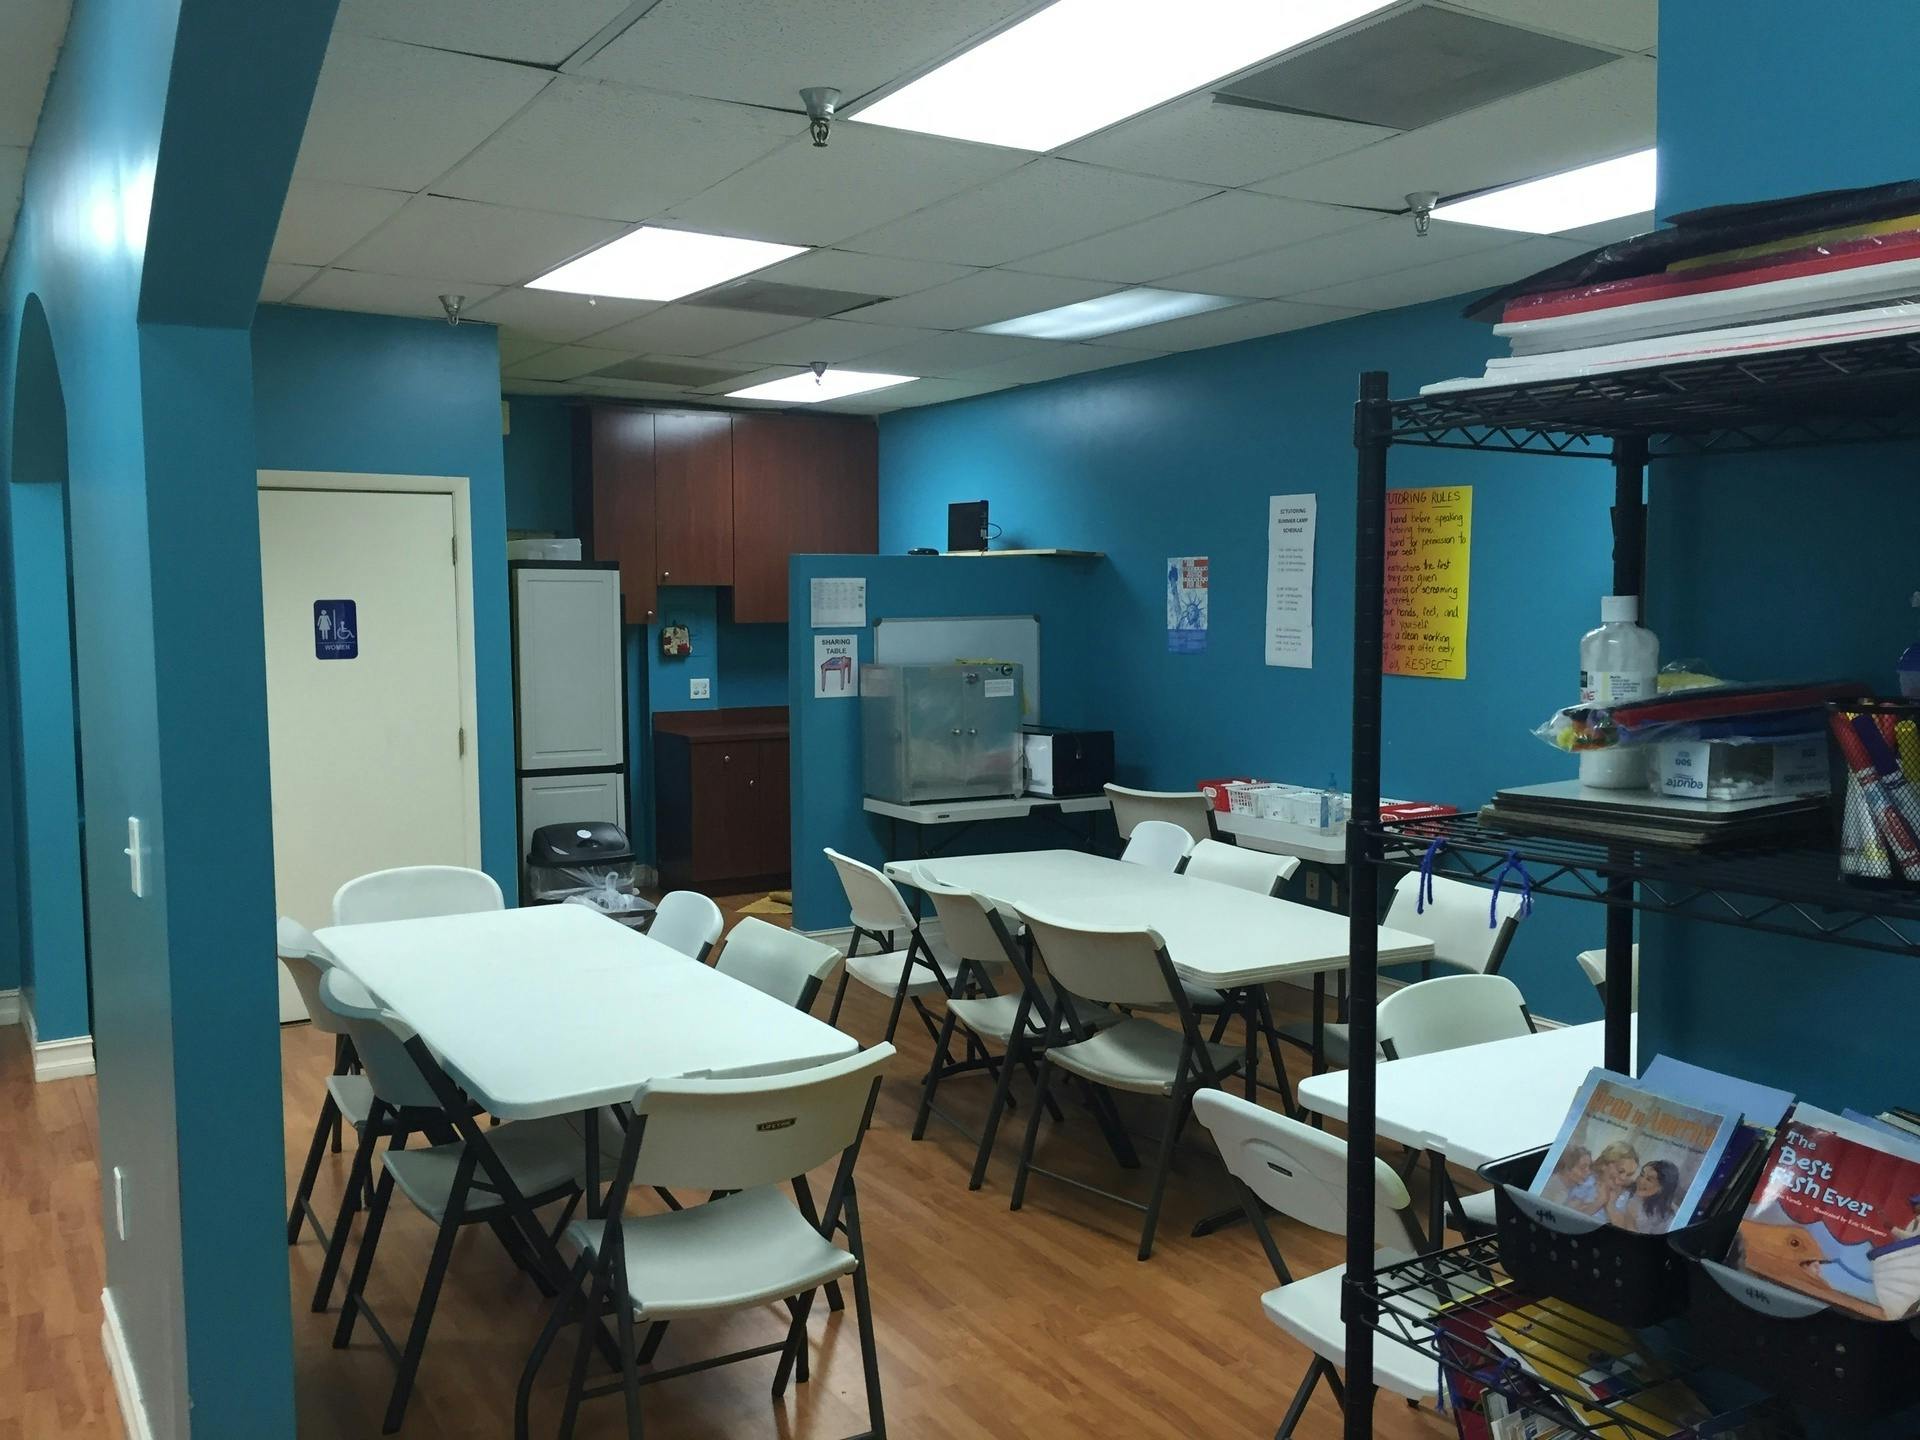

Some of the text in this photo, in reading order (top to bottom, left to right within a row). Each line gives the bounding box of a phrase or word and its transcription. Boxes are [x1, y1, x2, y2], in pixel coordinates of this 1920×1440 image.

[1431, 491, 1461, 504] RULES
[1390, 512, 1463, 527] hand before speaking
[1422, 537, 1455, 551] permission
[1458, 532, 1466, 544] to
[1423, 559, 1435, 570] the
[1437, 558, 1451, 570] first
[1417, 574, 1437, 587] given
[1422, 585, 1458, 600] screaming
[1444, 606, 1459, 618] and
[1399, 619, 1429, 632] yourself
[1401, 631, 1419, 640] clean
[1423, 632, 1450, 647] working
[1405, 656, 1453, 671] RESPECT
[1666, 777, 1704, 790] equate
[1786, 1129, 1817, 1150] The
[1778, 1145, 1833, 1180] Best
[1822, 1187, 1874, 1217] Ever
